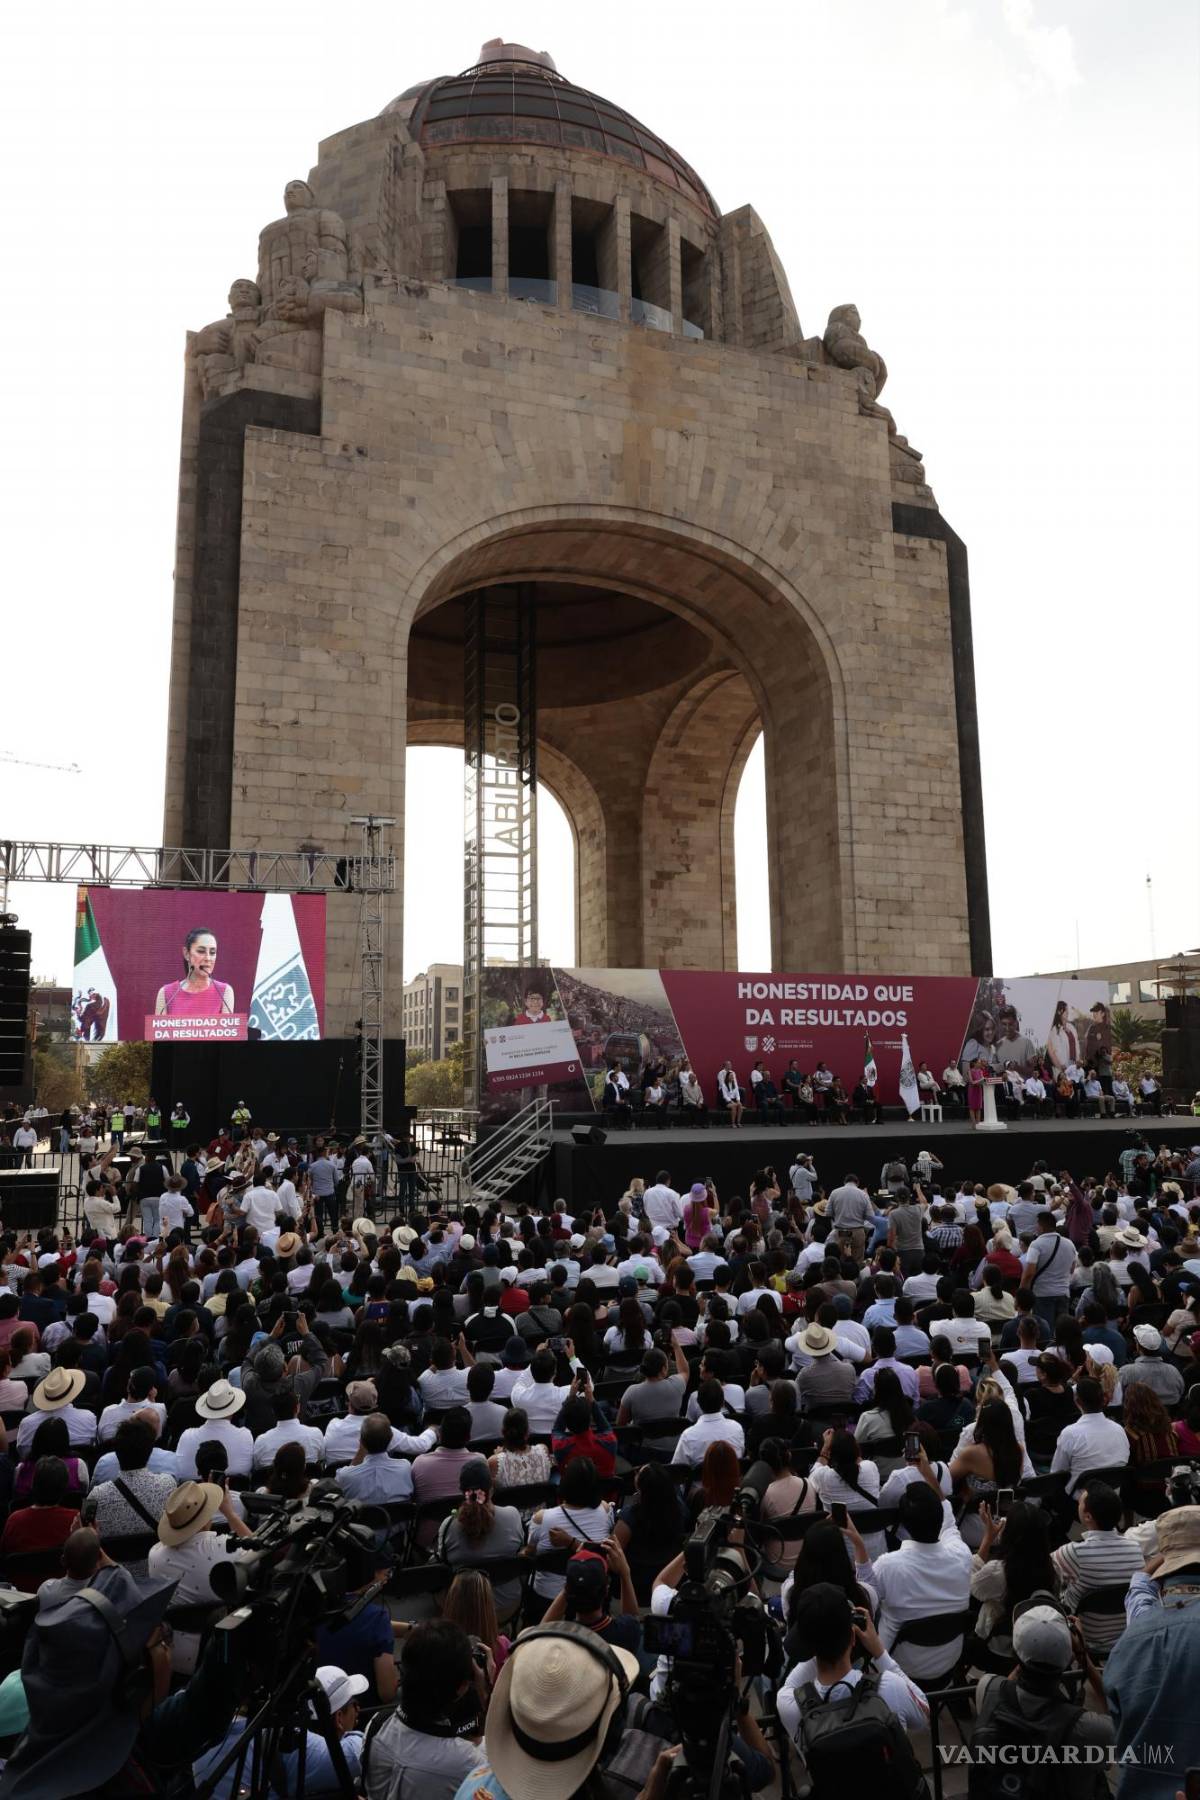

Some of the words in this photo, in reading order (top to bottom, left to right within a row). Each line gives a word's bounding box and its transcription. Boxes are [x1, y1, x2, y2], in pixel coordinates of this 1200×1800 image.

[494, 703, 521, 848] ABIERTO
[738, 982, 869, 1001] HONESTIDAD
[874, 985, 913, 1002] QUE
[152, 1018, 217, 1028] HONESTIDAD
[220, 1018, 240, 1027] QUE
[746, 1008, 775, 1025] DA
[780, 1009, 908, 1027] RESULTADOS
[154, 1030, 170, 1038] DA
[172, 1029, 238, 1038] RESULTADOS
